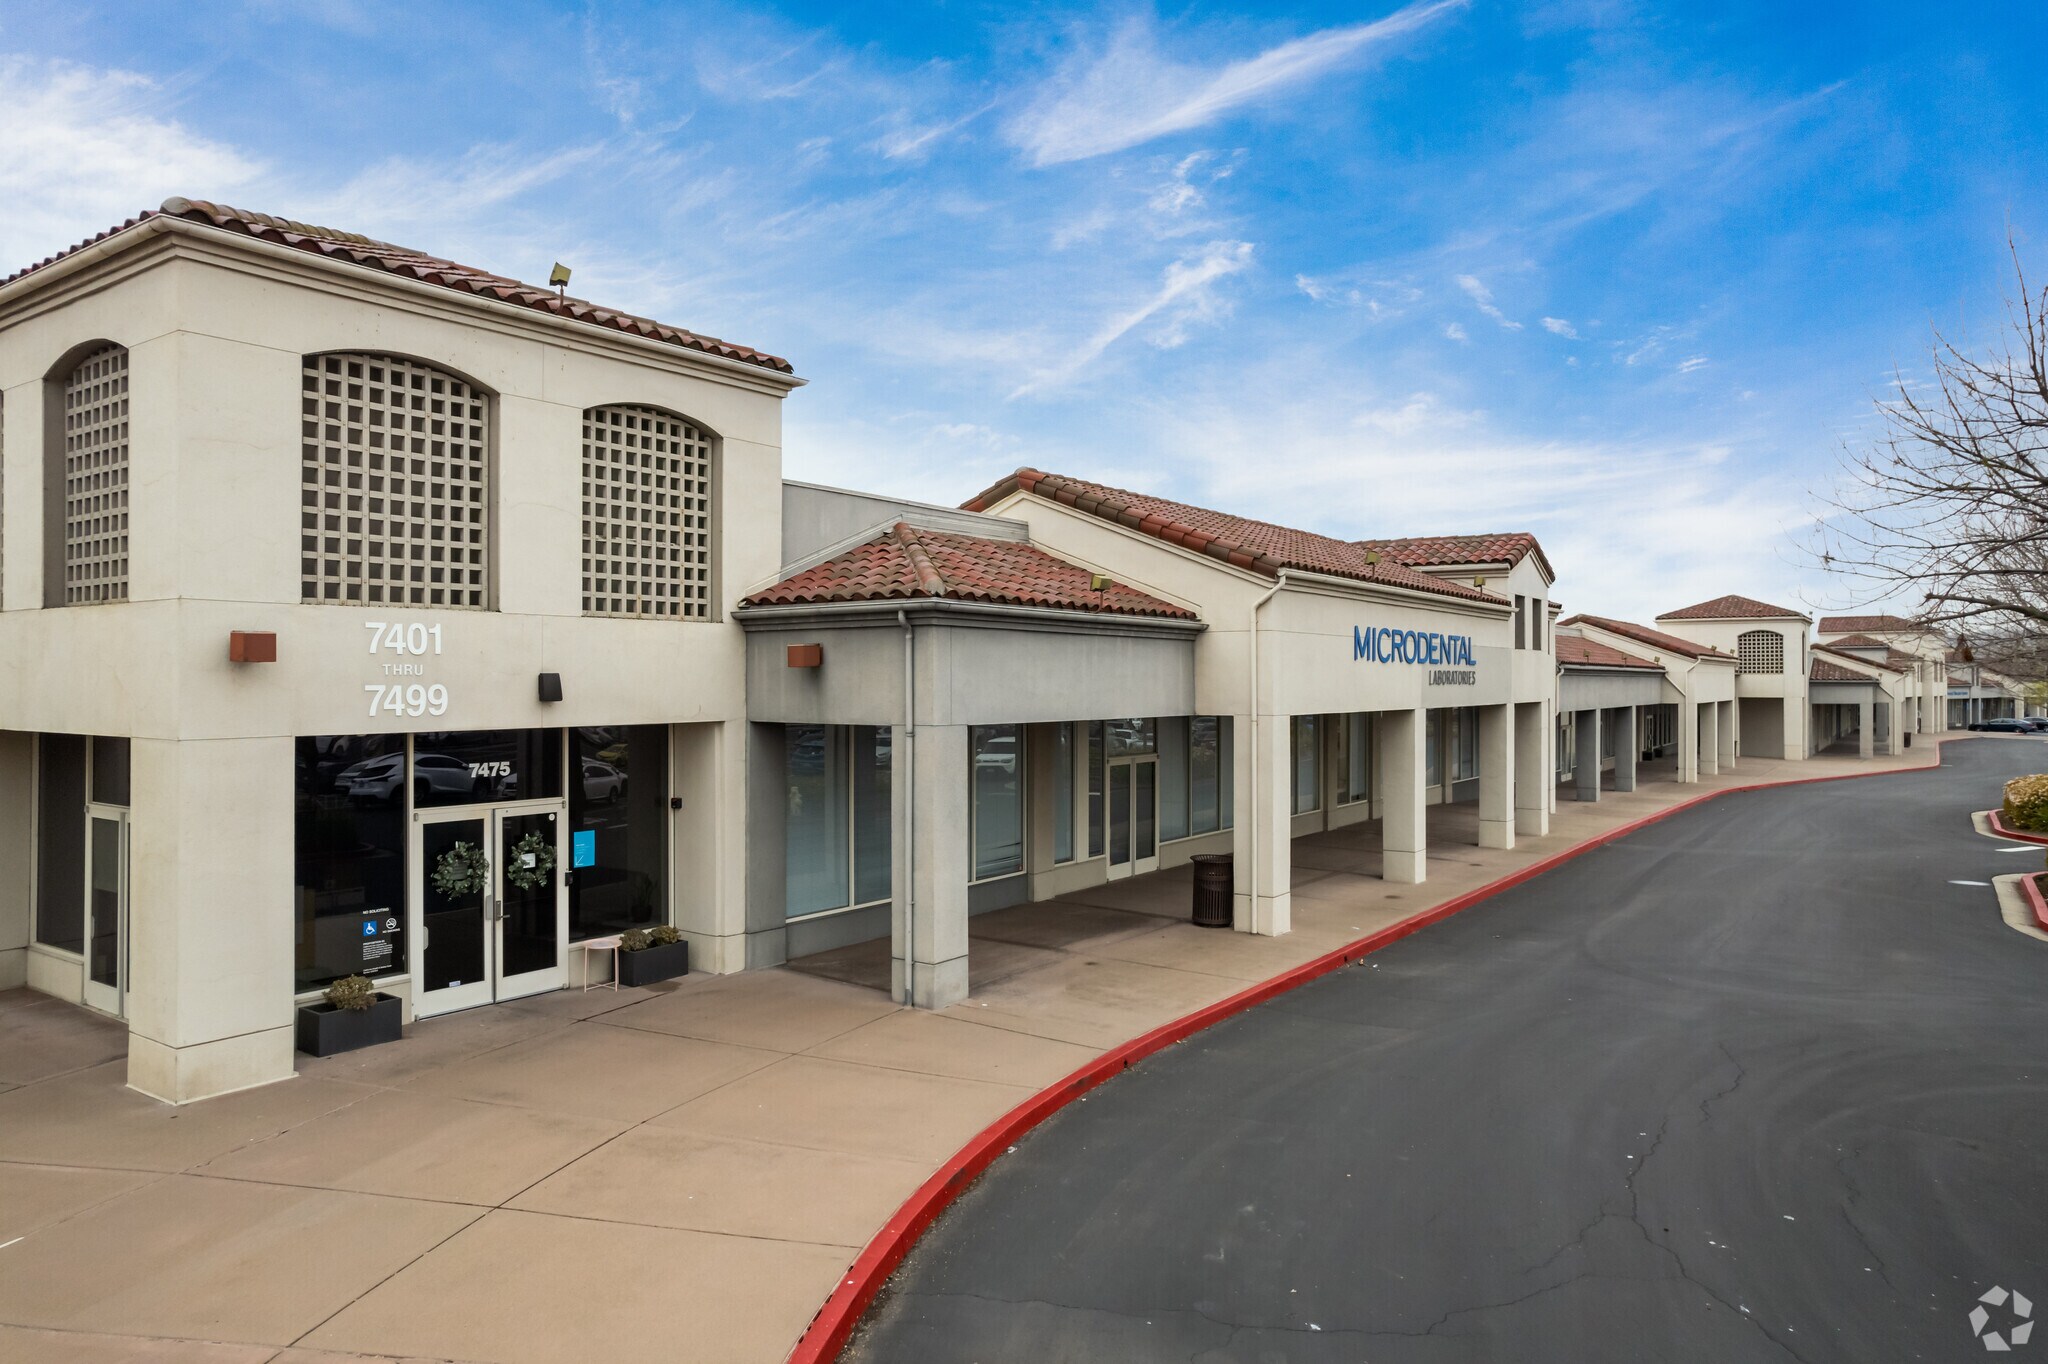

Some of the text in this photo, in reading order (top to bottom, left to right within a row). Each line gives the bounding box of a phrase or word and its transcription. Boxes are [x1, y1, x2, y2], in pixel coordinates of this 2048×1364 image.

[365, 621, 442, 656] 7401
[1353, 625, 1477, 666] MICRODENTAL
[382, 663, 424, 676] THRU
[1428, 669, 1476, 686] LABORATORIES
[364, 683, 449, 718] 7499
[468, 761, 511, 778] 7475
